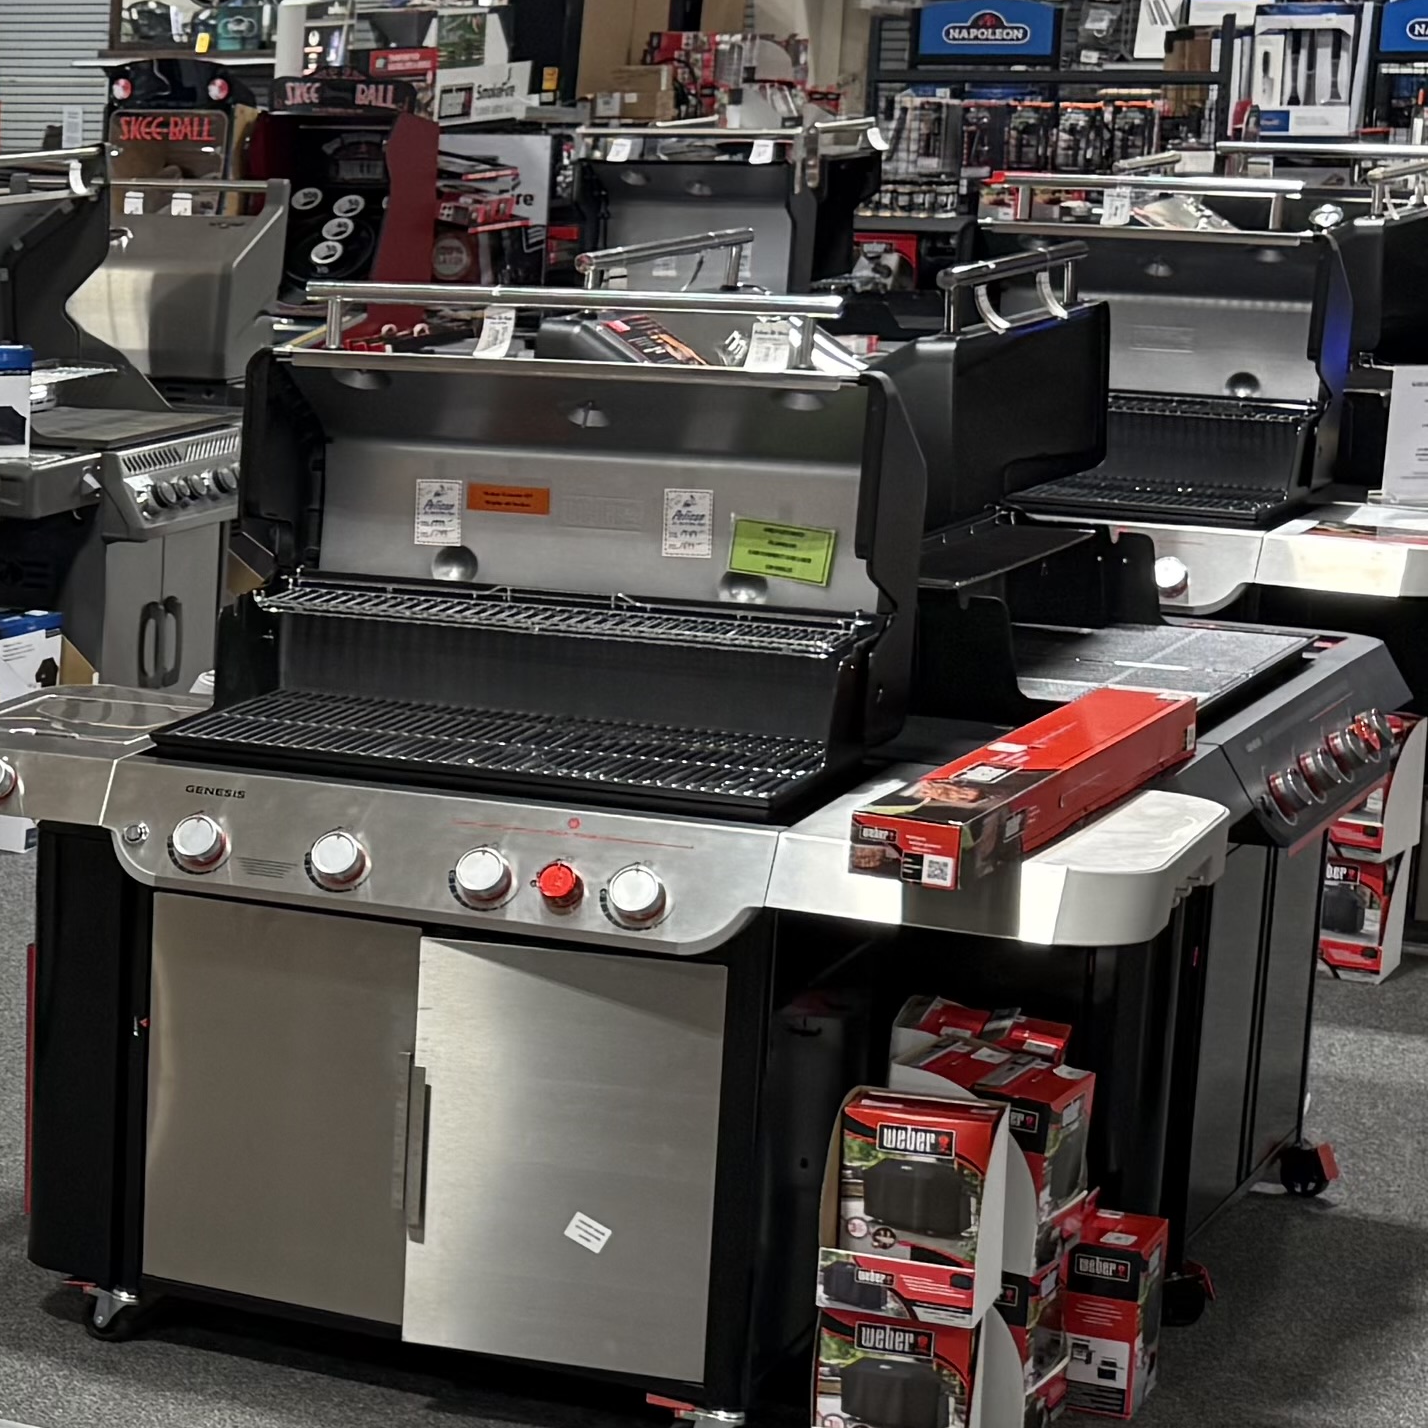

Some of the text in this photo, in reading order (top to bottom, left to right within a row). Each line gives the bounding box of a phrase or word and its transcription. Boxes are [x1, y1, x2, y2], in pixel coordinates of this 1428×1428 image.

[948, 28, 1024, 40] NAPOLEON
[283, 80, 396, 107] SKEE BALL
[119, 115, 216, 142] SKEE-BALL
[185, 785, 246, 799] GENESIS
[882, 1125, 936, 1152] weber
[858, 1270, 886, 1283] weber
[1079, 1258, 1117, 1275] weber
[861, 1324, 914, 1351] weber
